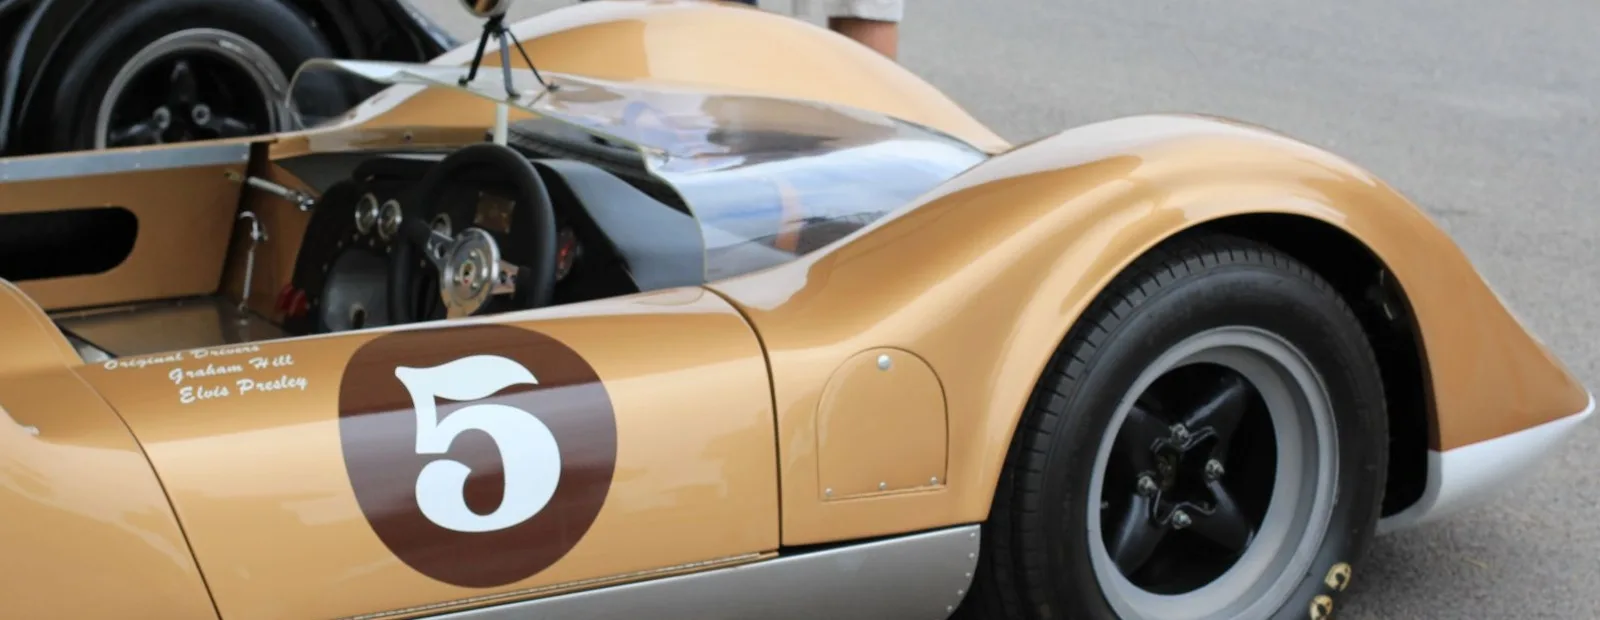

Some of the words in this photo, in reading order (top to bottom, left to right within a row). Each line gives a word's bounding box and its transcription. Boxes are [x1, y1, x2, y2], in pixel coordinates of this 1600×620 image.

[103, 352, 183, 371] Original
[190, 344, 260, 359] Drivers
[168, 363, 244, 385] Graham
[248, 353, 294, 369] Hill
[179, 385, 230, 404] Elvis
[235, 375, 308, 396] Presley
[394, 354, 562, 533] 5
